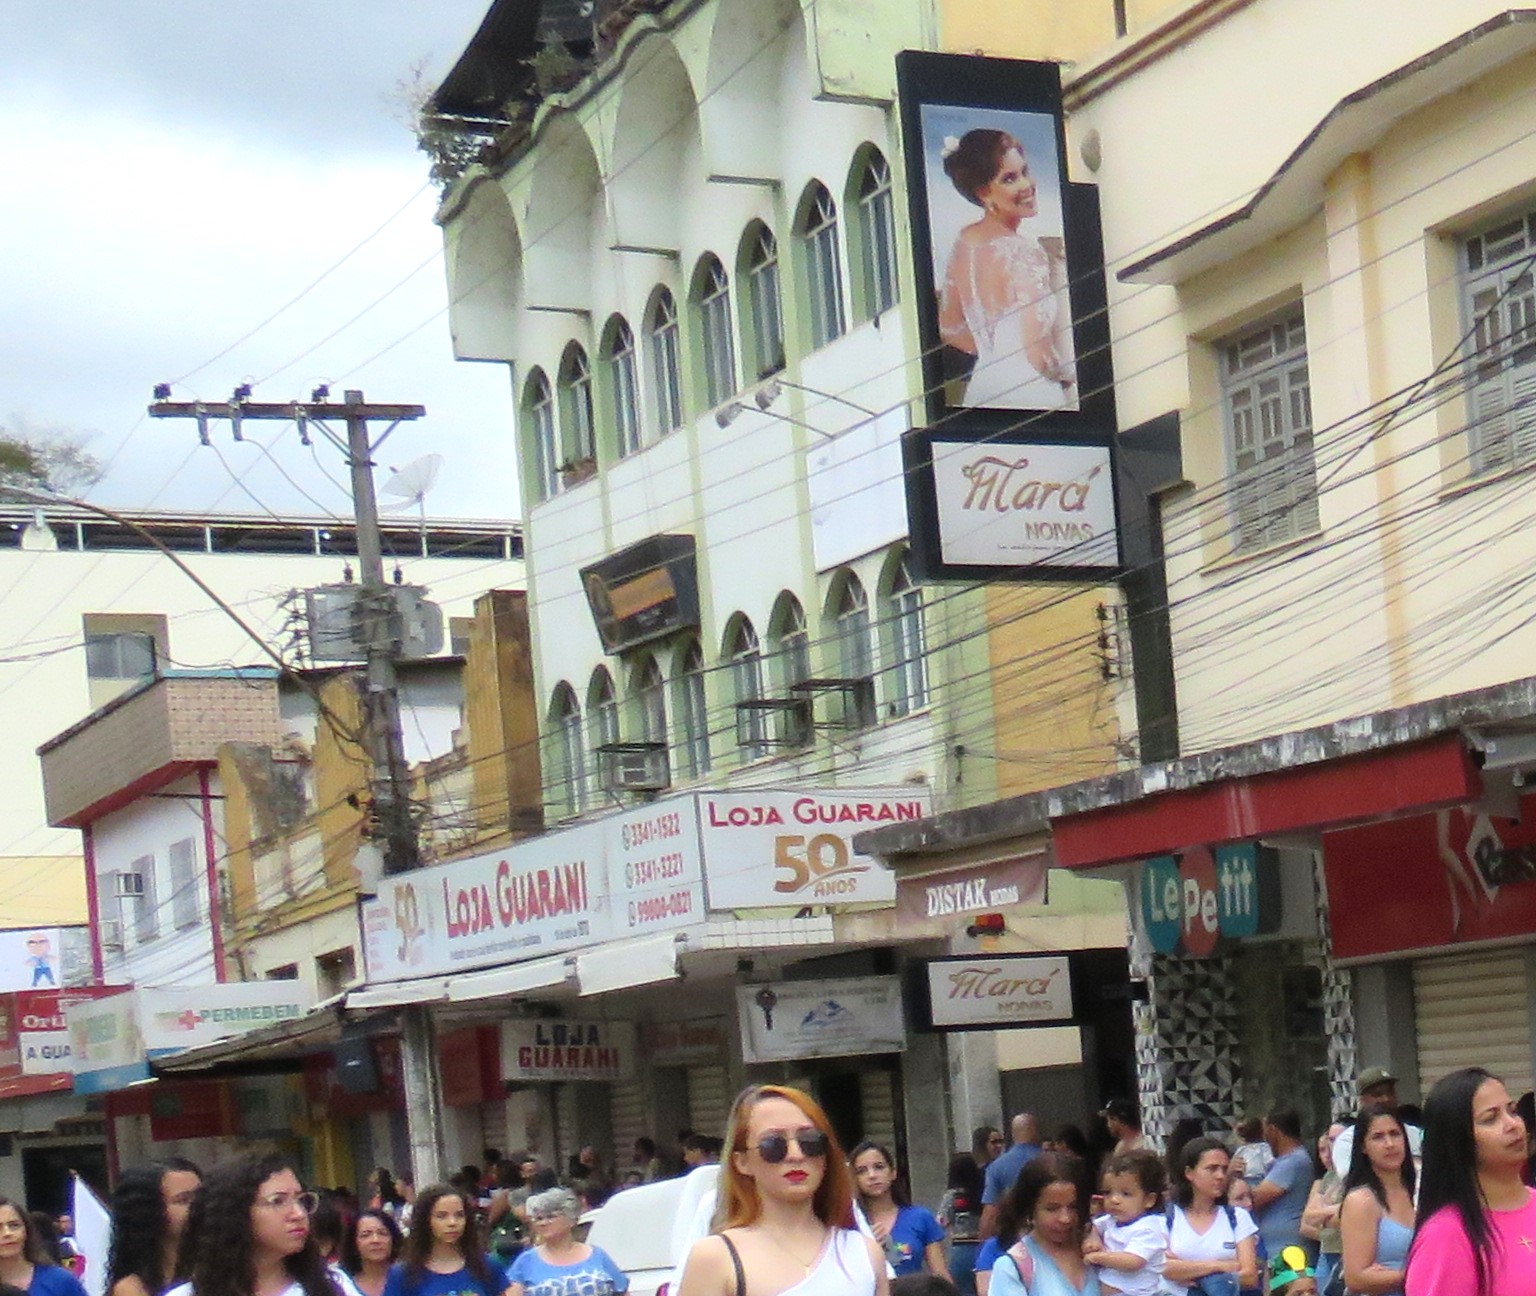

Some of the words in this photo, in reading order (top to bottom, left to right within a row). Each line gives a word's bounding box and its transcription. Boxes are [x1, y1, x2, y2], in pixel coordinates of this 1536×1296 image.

[1025, 521, 1094, 542] NOIVAS
[708, 801, 784, 828] LOJA
[792, 797, 923, 824] GUARANI
[773, 832, 852, 893] 50
[442, 876, 495, 939] LOJA
[496, 859, 588, 928] GUARANI
[925, 878, 988, 917] DISTAK
